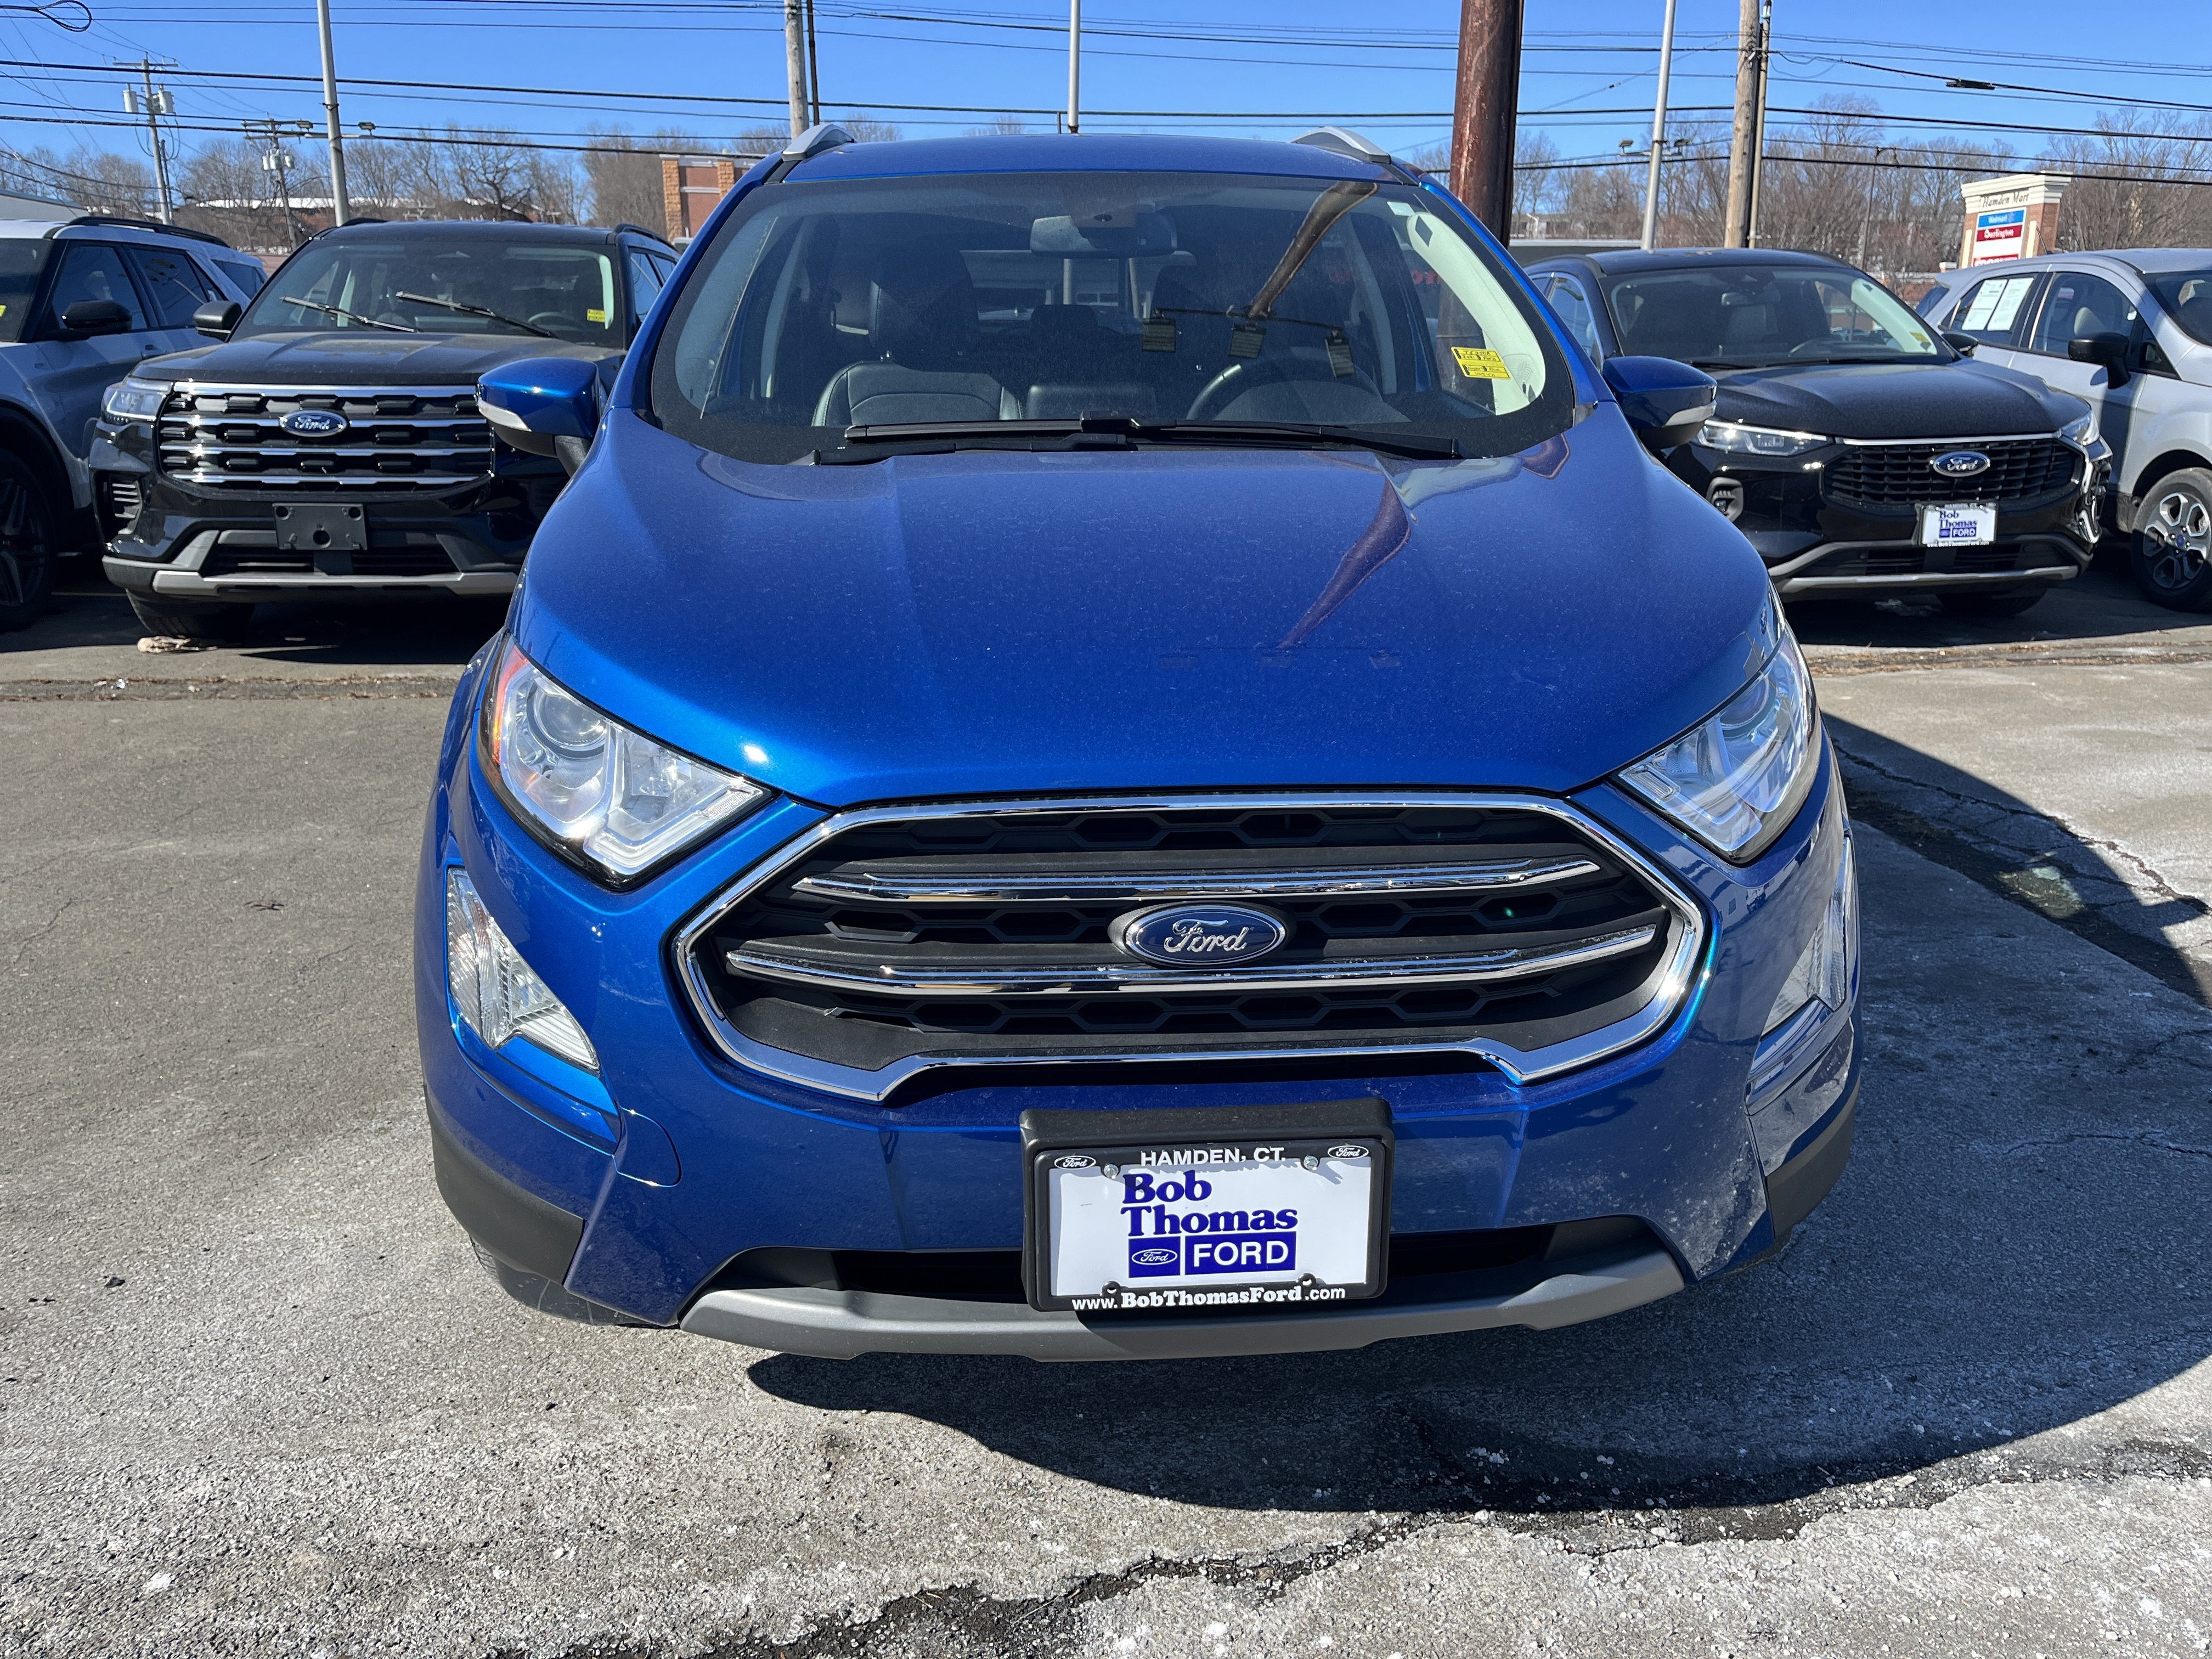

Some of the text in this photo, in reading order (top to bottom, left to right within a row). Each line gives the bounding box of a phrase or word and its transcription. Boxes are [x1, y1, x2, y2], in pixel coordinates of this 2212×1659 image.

[295, 415, 330, 430] Ford
[1948, 456, 1978, 471] Ford
[1939, 509, 1959, 519] Bob
[1939, 518, 1978, 528] Thomas
[1953, 528, 1976, 537] FORD
[1163, 918, 1250, 952] Ford
[1141, 1147, 1286, 1166] HAMDEN, CT.
[1336, 1147, 1361, 1157] Ford
[1063, 1157, 1088, 1167] Ford
[1122, 1170, 1212, 1204] Bob
[1120, 1204, 1298, 1237] Thomas
[1140, 1251, 1169, 1262] Ford
[1193, 1240, 1289, 1267] FORD
[1071, 1286, 1346, 1310] www.BobThomasFord.com
